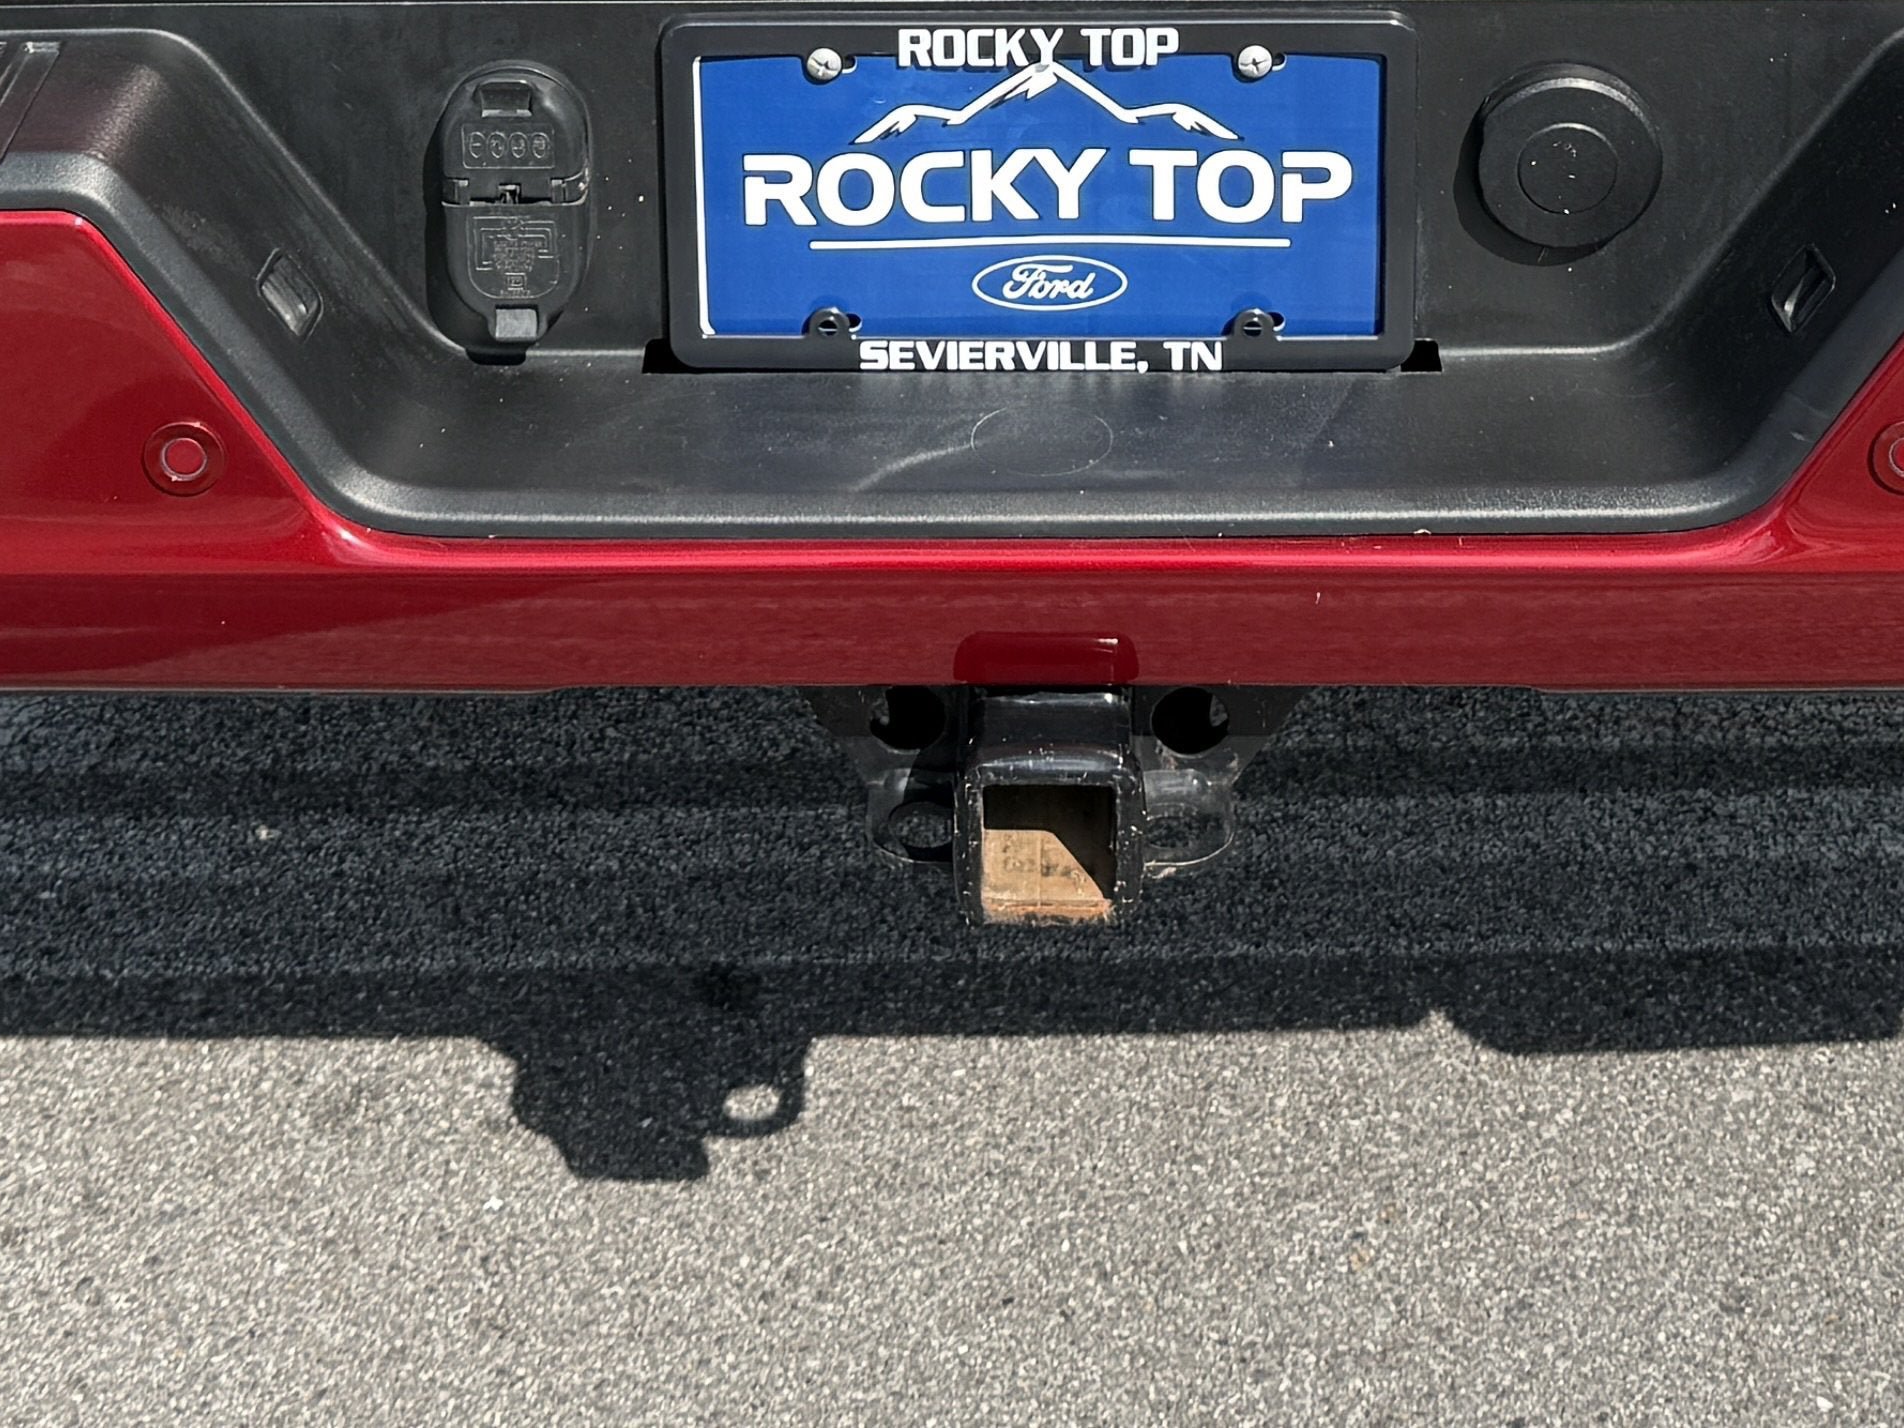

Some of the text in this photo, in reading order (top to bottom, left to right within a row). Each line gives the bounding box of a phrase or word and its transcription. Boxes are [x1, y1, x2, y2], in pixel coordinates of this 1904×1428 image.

[897, 27, 1179, 68] ROCKY TOP
[743, 147, 1354, 227] ROCKY TOP
[1002, 263, 1095, 302] Ford
[859, 339, 1223, 375] SEVIERVILLE, TN
